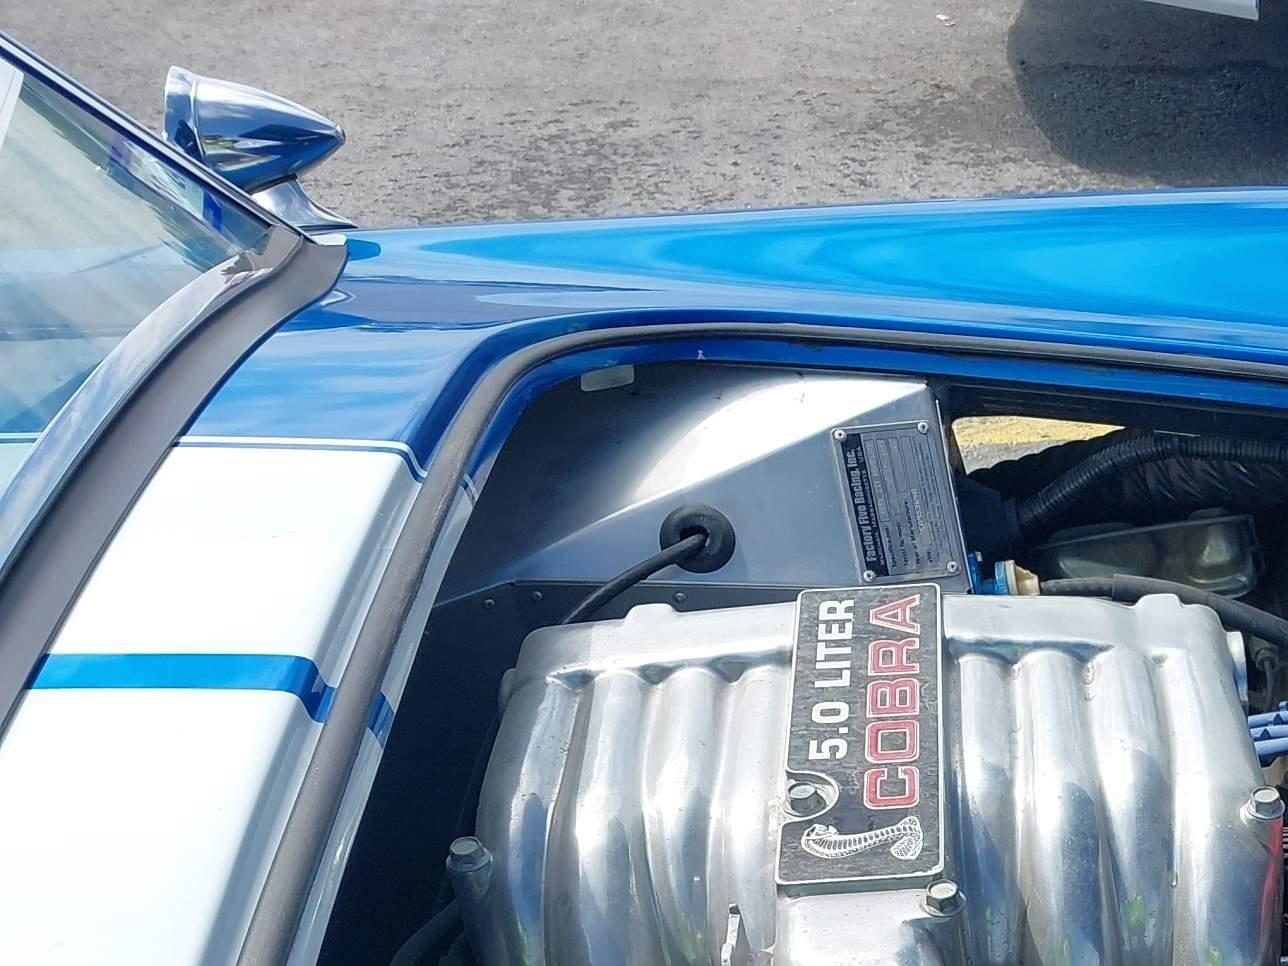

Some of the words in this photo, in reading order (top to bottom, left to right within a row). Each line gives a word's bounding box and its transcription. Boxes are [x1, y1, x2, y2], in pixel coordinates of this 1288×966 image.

[856, 504, 869, 524] Five
[861, 524, 876, 561] Factory
[815, 600, 853, 688] LITER
[809, 701, 848, 760] 5.0
[863, 594, 921, 810] COBRA
